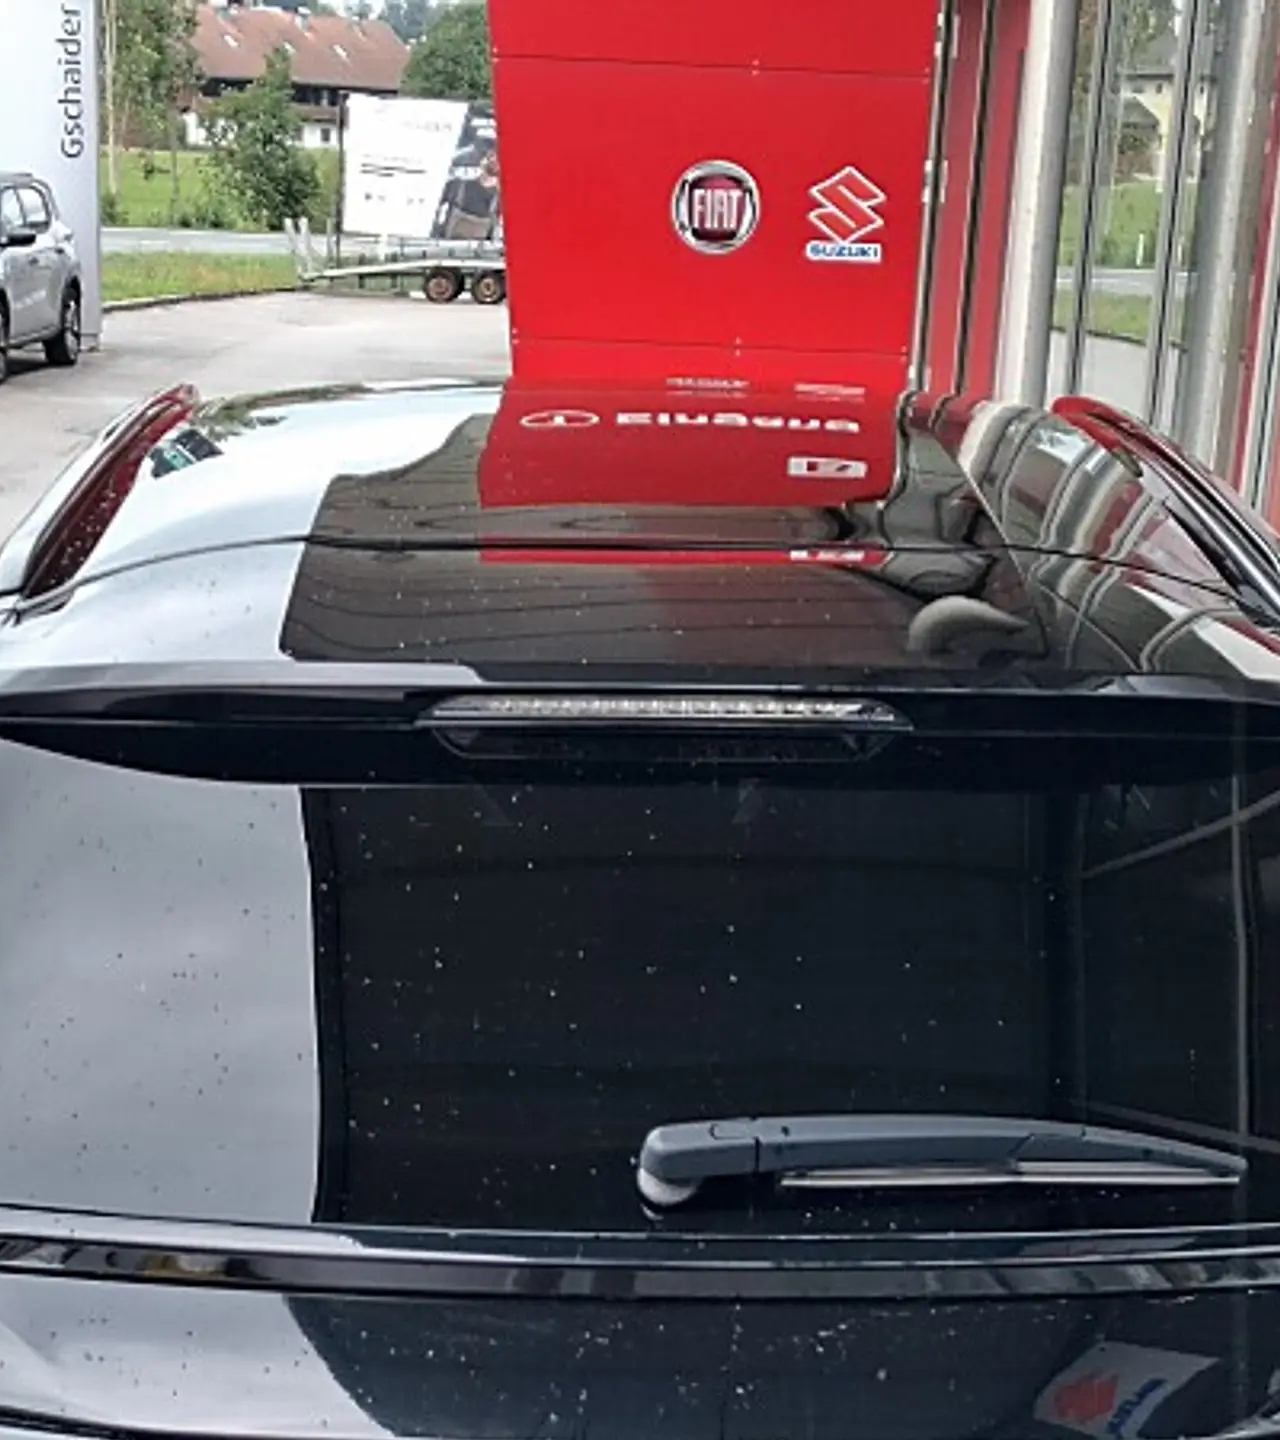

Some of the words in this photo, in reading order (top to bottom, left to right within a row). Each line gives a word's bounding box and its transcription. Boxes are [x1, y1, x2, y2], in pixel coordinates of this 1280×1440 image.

[54, 3, 85, 159] Gschaider
[693, 188, 743, 230] FIAT
[809, 244, 879, 258] SUZUKI
